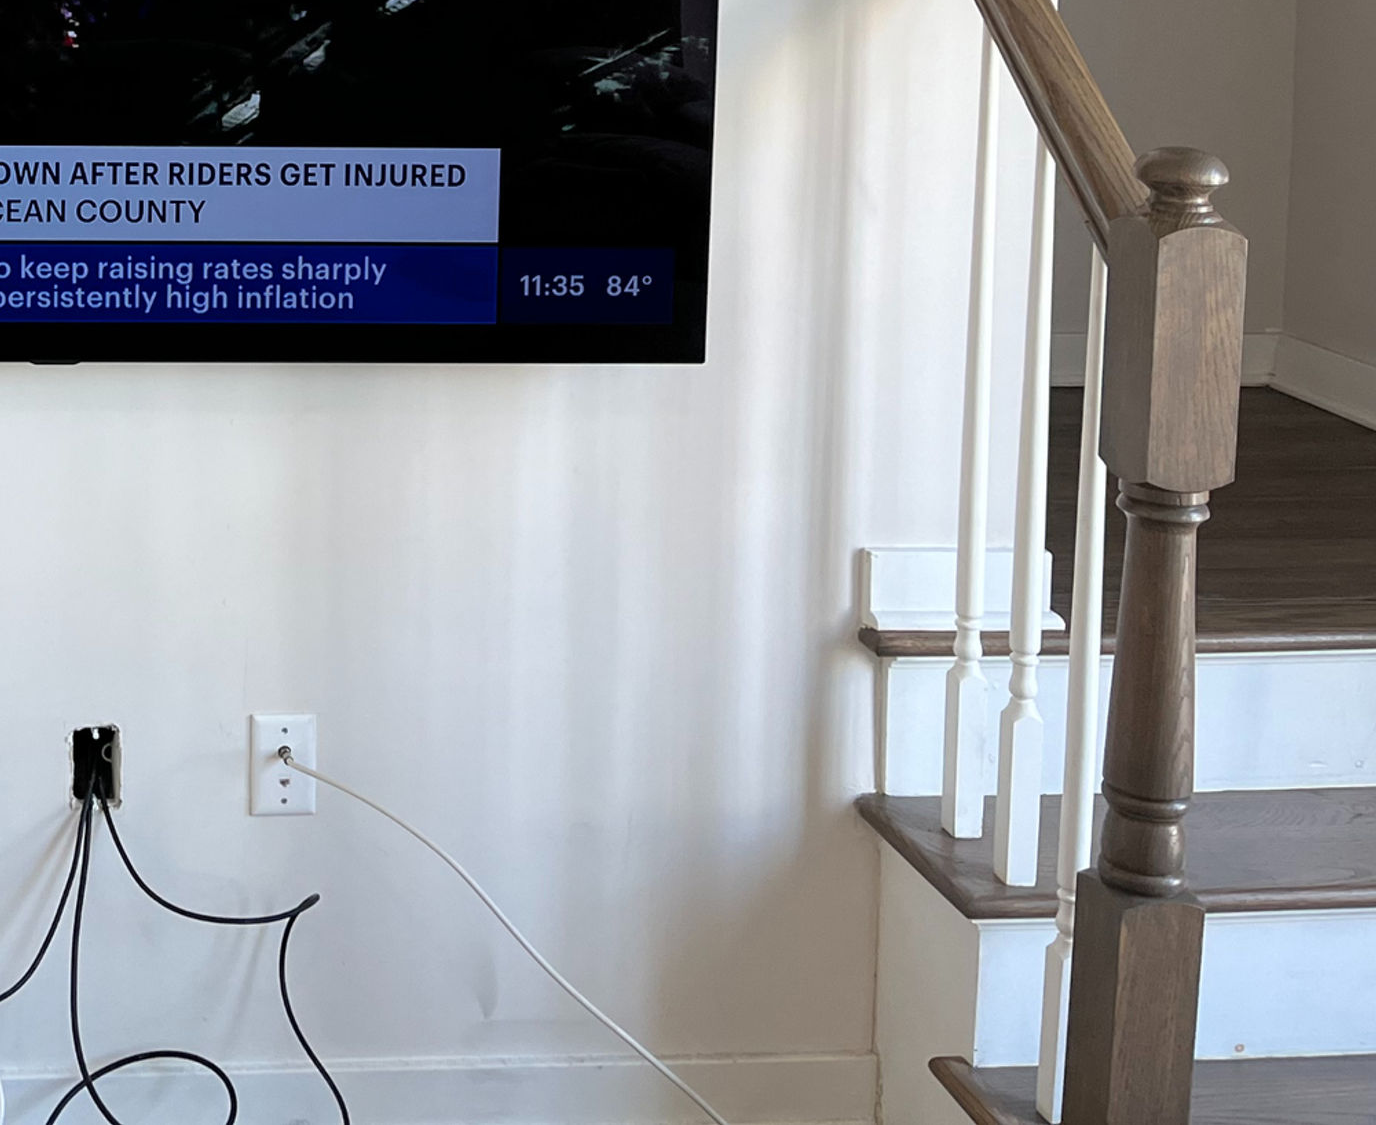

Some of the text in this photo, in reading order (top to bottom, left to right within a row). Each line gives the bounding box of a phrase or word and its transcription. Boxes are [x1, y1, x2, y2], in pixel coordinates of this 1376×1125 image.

[69, 161, 159, 186] AFTER
[168, 162, 271, 187] RIDERS
[280, 162, 336, 187] GET
[344, 163, 466, 188] INJURED
[75, 199, 206, 224] COUNTY
[20, 255, 89, 284] keep
[98, 256, 193, 284] raising
[203, 259, 274, 280] rates
[281, 256, 387, 285] sharply
[520, 274, 652, 297] 11:35 84°
[166, 285, 228, 315] high
[238, 285, 354, 309] inflation
